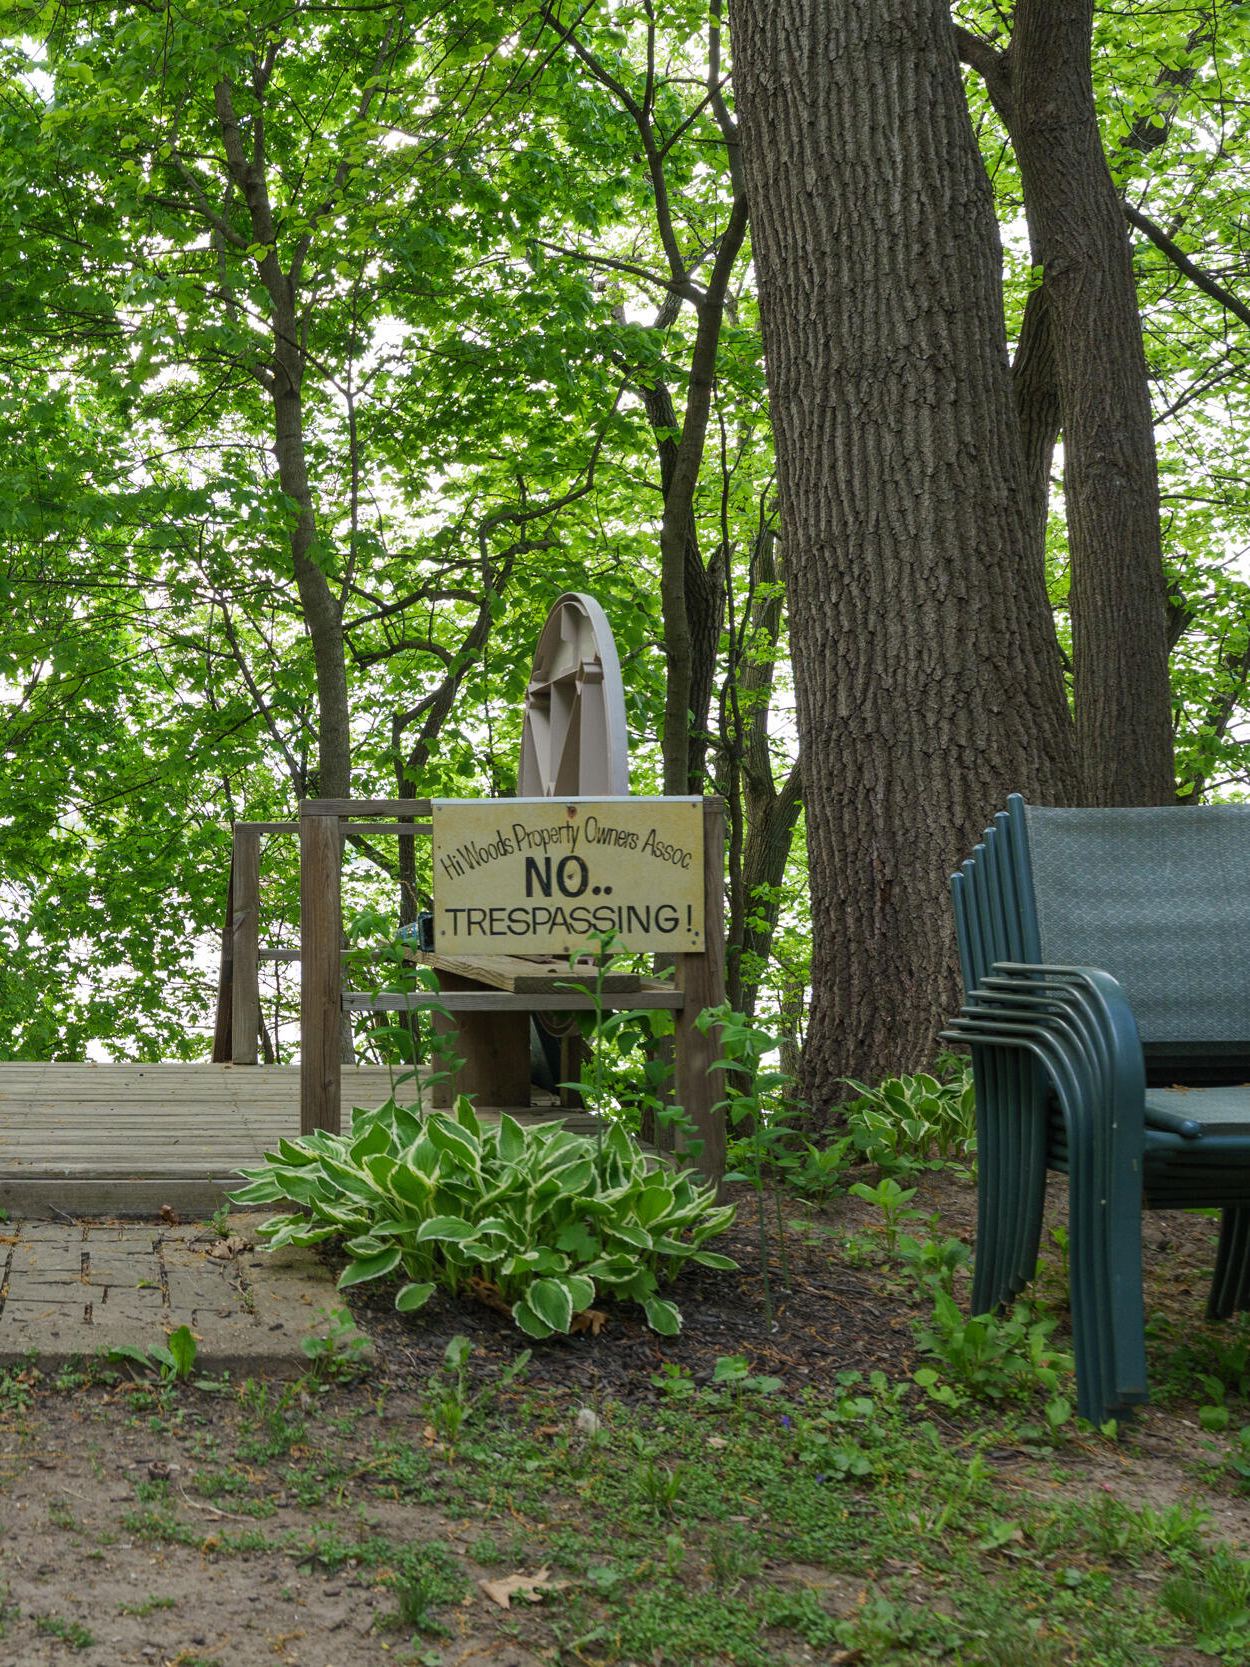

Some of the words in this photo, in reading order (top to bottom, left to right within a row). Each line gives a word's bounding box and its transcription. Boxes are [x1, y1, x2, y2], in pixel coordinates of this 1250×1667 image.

[512, 821, 580, 854] Property
[584, 816, 639, 850] Owners
[641, 828, 692, 870] Assoc.
[444, 904, 692, 936] TRESPASSING!
